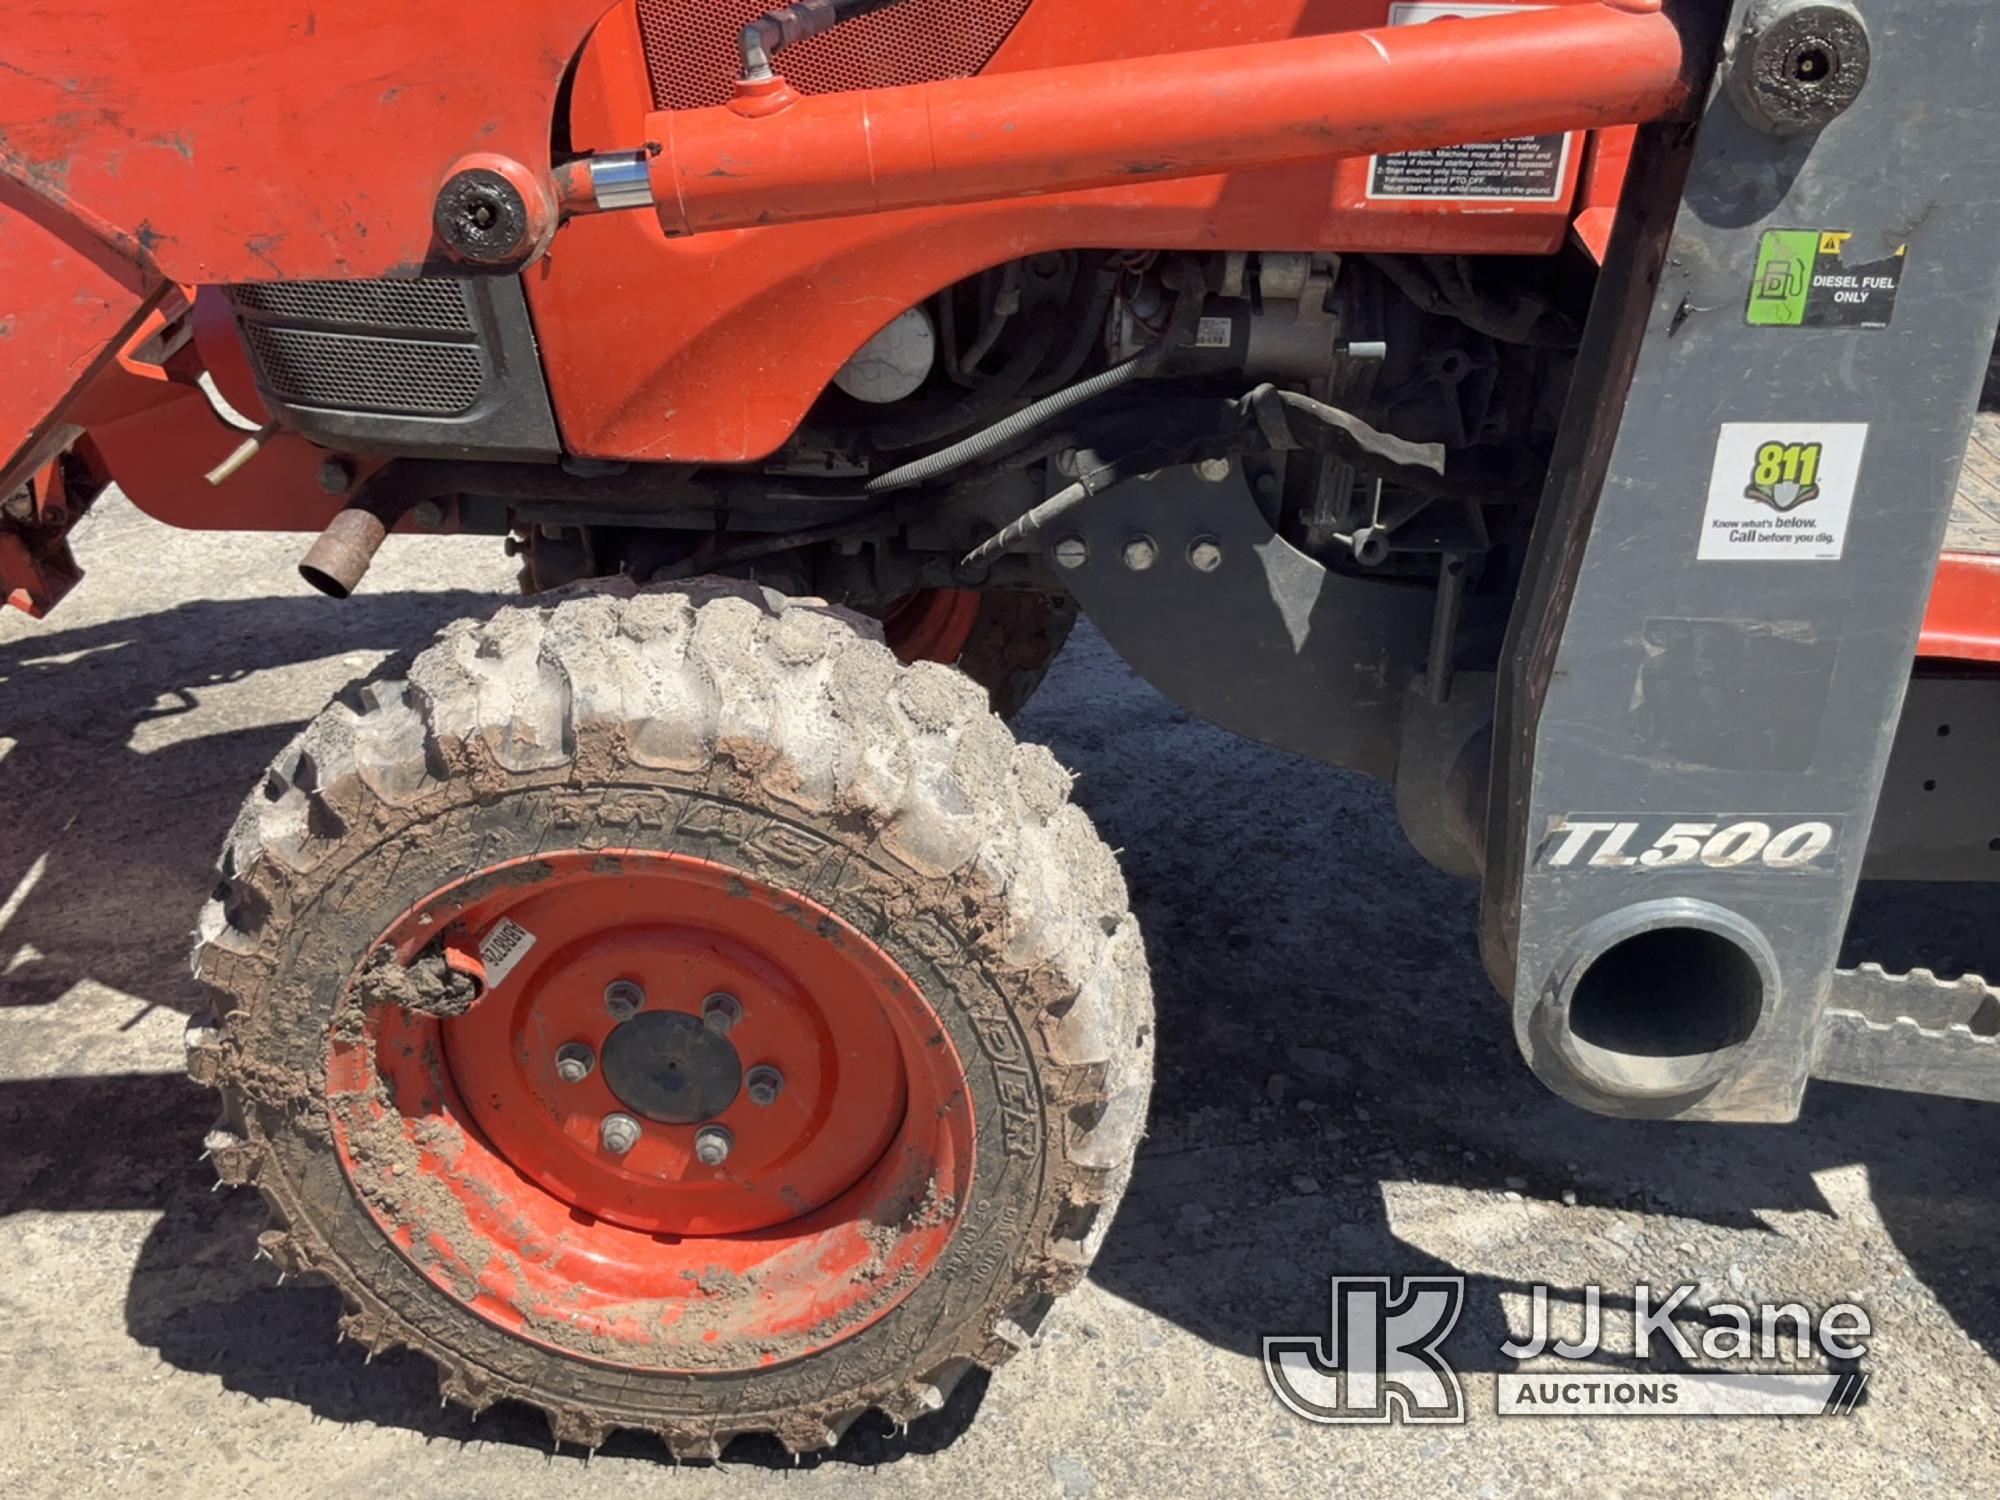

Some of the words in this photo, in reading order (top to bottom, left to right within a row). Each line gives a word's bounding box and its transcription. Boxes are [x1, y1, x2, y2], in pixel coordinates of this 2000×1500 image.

[1517, 143, 1540, 151] safety
[1436, 150, 1469, 158] Machine
[1471, 152, 1487, 160] may
[1517, 152, 1535, 160] gear
[1409, 158, 1416, 166] if
[1445, 160, 1474, 168] starting
[1385, 166, 1405, 174] Start
[1406, 168, 1432, 176] engine
[1433, 168, 1450, 176] only
[1383, 184, 1405, 192] Never
[1424, 186, 1448, 194] engine
[1470, 186, 1501, 194] standing
[1813, 275, 1859, 288] DIESEL
[1862, 277, 1895, 288] FUEL
[1834, 291, 1869, 303] ONLY
[1754, 443, 1820, 486] 811
[1712, 519, 1740, 529] Know
[1741, 519, 1773, 529] what's
[1775, 516, 1817, 529] below.
[1729, 529, 1757, 543] Call
[1758, 533, 1793, 543] before
[1794, 535, 1815, 544] you
[1815, 533, 1834, 544] dig.
[1549, 821, 1833, 868] TL500
